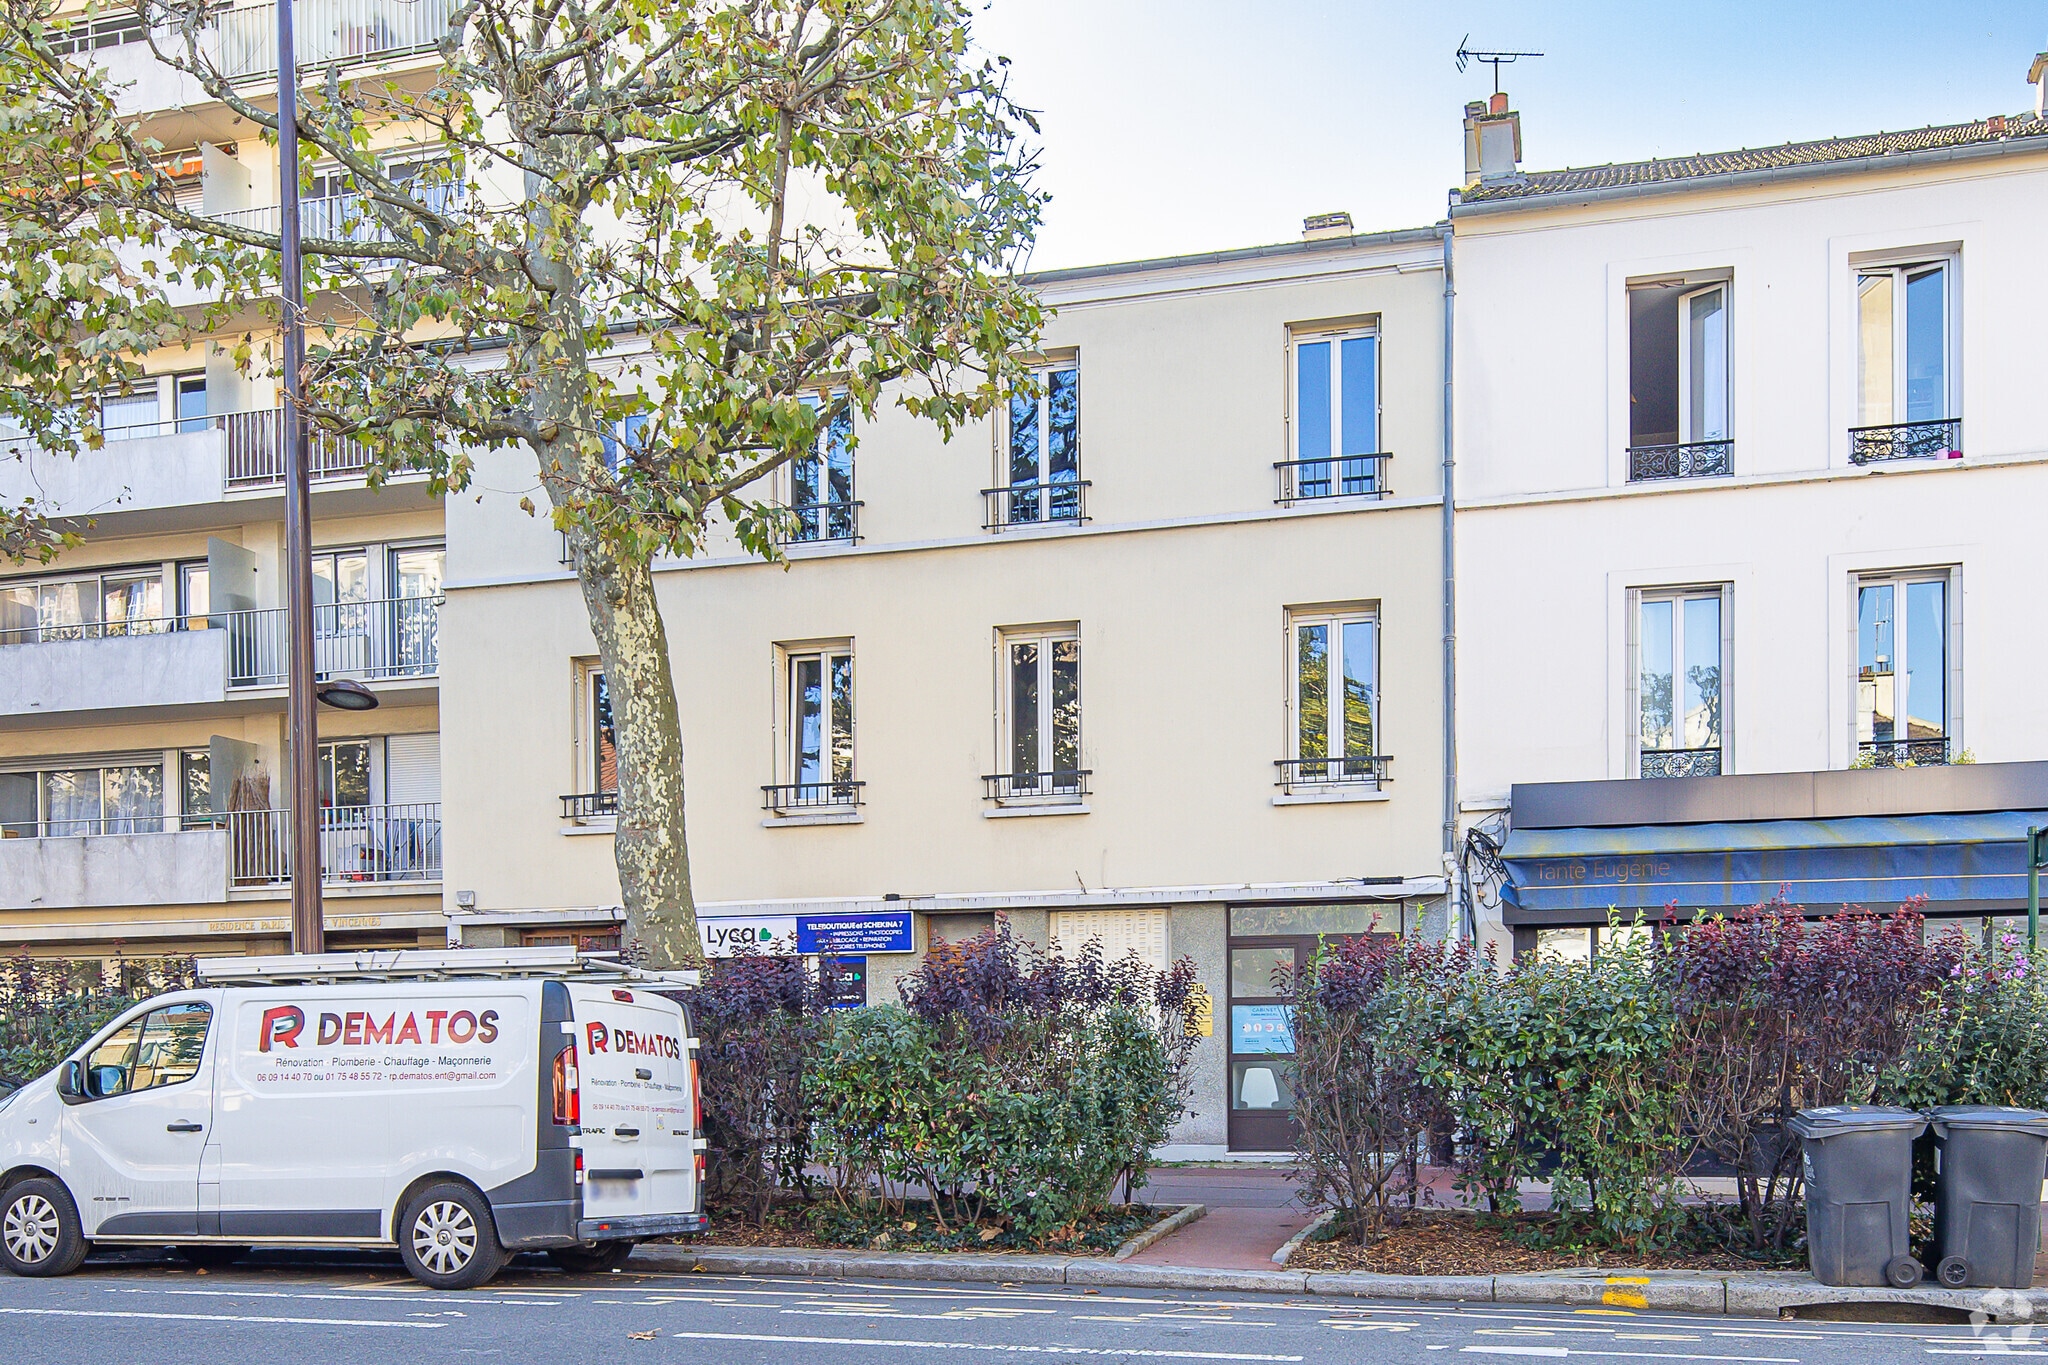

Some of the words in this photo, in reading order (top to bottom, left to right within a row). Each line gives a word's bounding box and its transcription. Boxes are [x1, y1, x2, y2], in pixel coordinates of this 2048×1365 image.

[1536, 862, 1586, 880] Tante
[209, 920, 255, 931] RESIDENCE
[260, 920, 285, 930] PARIS
[331, 916, 381, 928] VINCENNES
[806, 922, 855, 931] TELEBOUTIQUE
[863, 920, 898, 930] SCHEKINA
[898, 920, 904, 928] 7
[707, 925, 756, 947] Lyca
[856, 942, 887, 950] TELEPHONES
[317, 1009, 499, 1046] DEMATOS
[613, 1028, 680, 1060] DEMATOS
[275, 1057, 324, 1067] Rénovation
[332, 1057, 376, 1067] Plomberie
[383, 1056, 430, 1068] Chauffage
[438, 1055, 492, 1067] Maçonnerie
[257, 1073, 266, 1081] 06
[268, 1073, 278, 1081] 09
[280, 1073, 289, 1081] 14
[291, 1073, 301, 1081] 40
[303, 1072, 312, 1081] 70
[325, 1072, 335, 1081] 01
[337, 1072, 347, 1081] 75
[348, 1072, 359, 1081] 48
[360, 1072, 371, 1081] 55
[372, 1071, 382, 1081] 72
[388, 1071, 496, 1081] rp.dematos.ent@gmail.com
